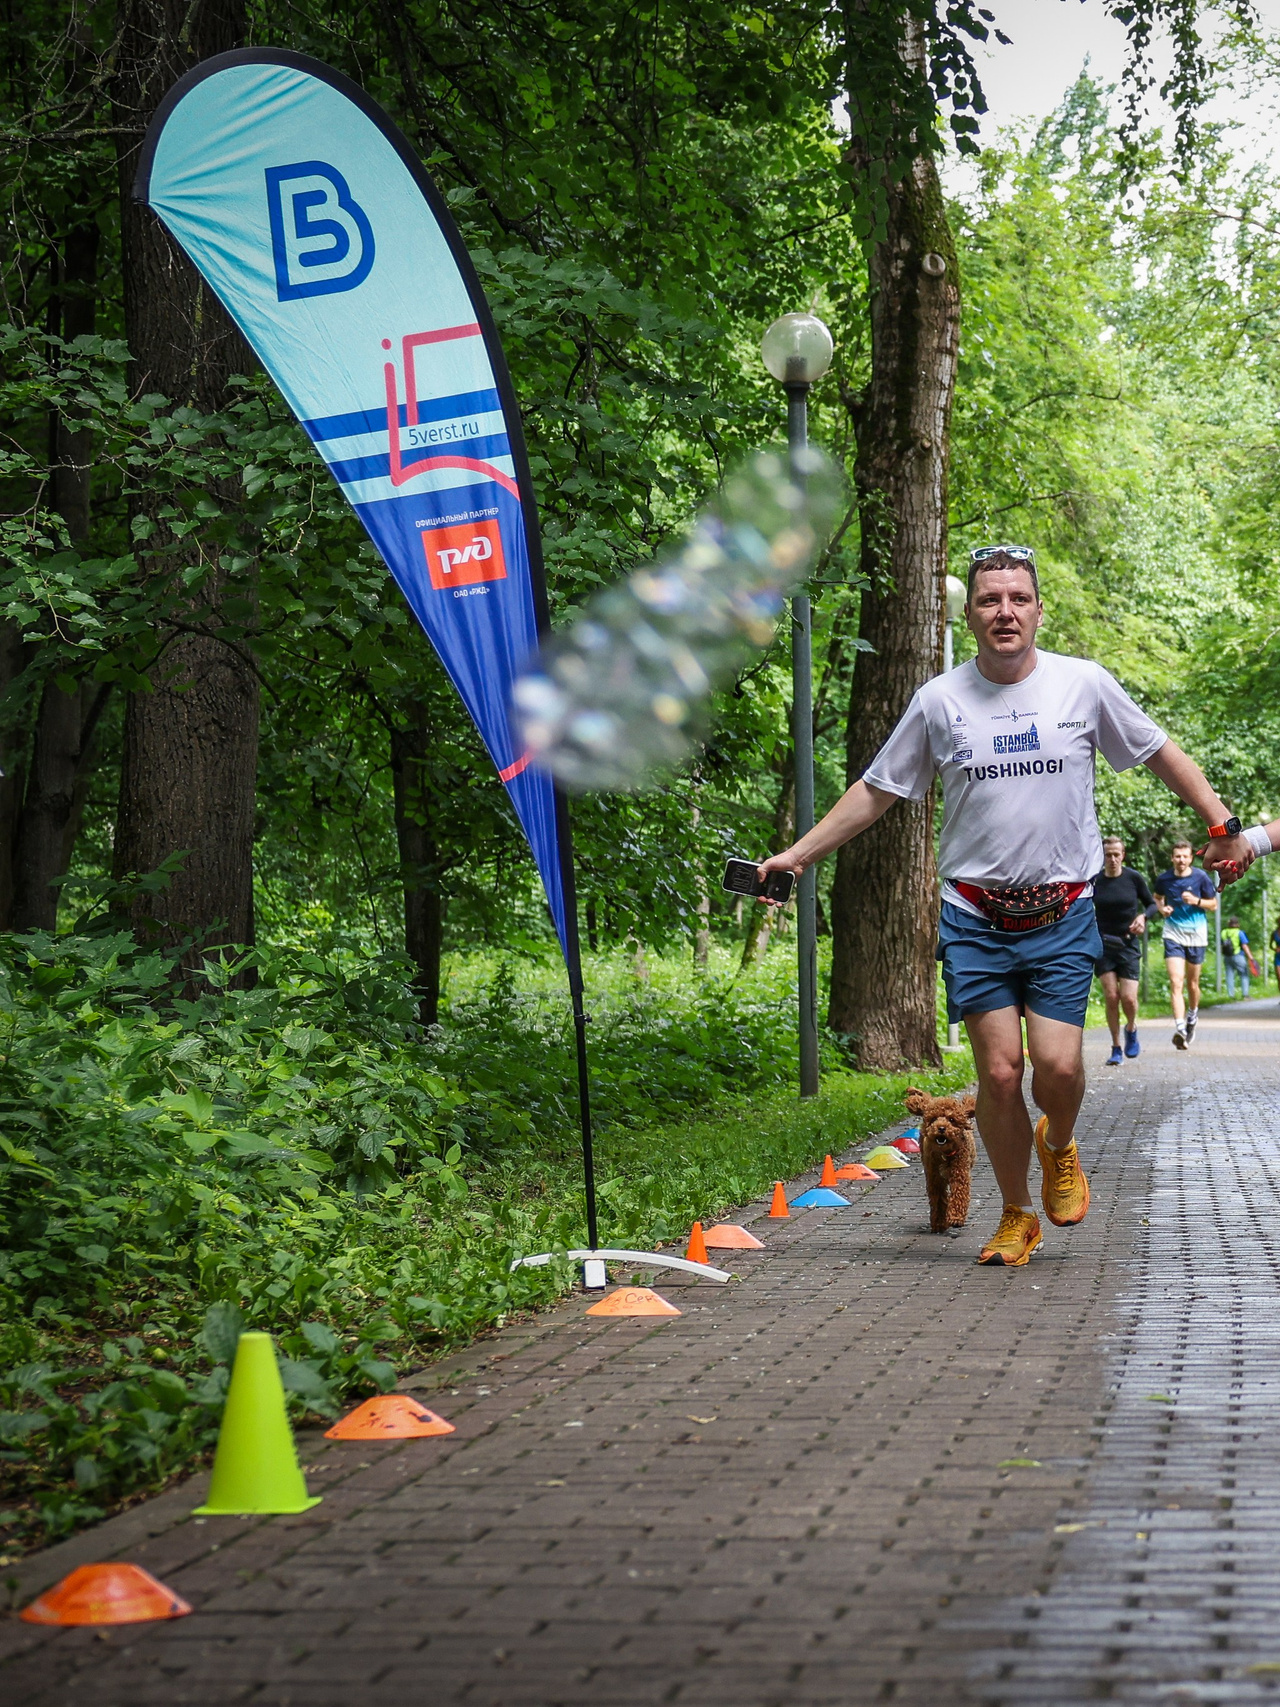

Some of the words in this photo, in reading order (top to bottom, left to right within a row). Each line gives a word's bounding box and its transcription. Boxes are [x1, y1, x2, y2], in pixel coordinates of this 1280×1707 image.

[408, 421, 480, 446] 5verst.ru
[415, 511, 469, 528] ОФИЦИАЛЬНЫЙ
[469, 507, 499, 520] ПАРТНЕР
[453, 589, 469, 598] ОАО
[963, 758, 1063, 782] TUSHINOGI
